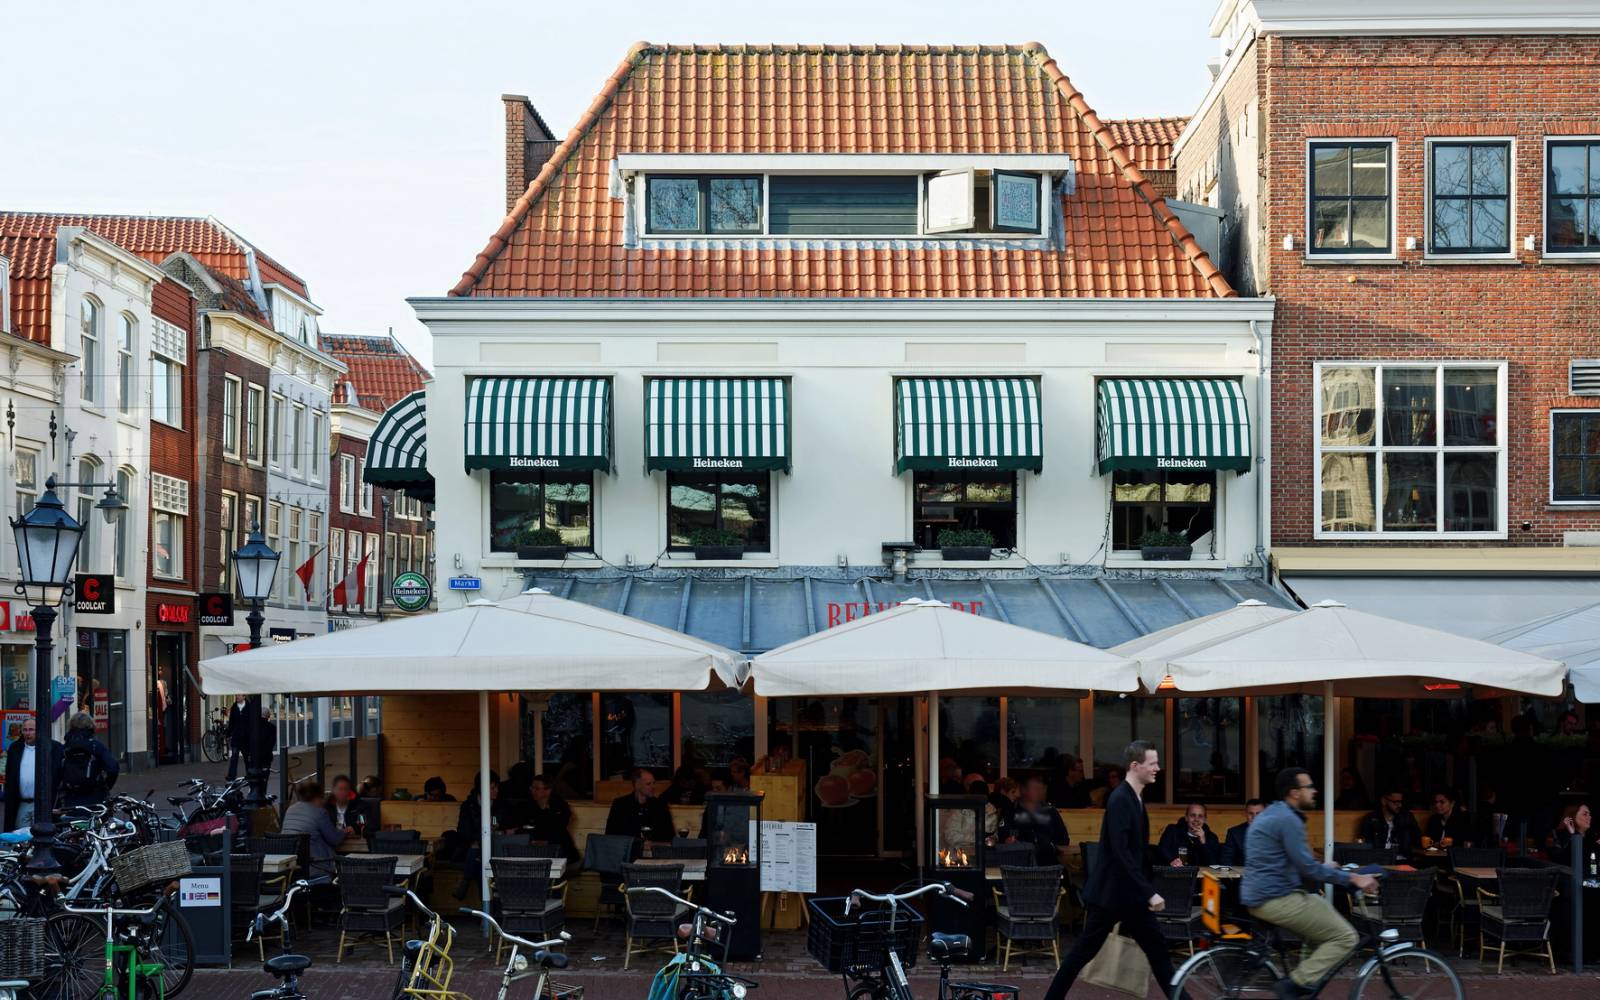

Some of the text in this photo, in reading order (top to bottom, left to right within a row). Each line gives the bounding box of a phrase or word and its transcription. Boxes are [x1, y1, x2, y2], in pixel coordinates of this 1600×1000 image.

[509, 457, 560, 468] Heineken
[692, 458, 743, 469] Heineken
[948, 457, 999, 468] Heineken
[1156, 457, 1208, 468] Heineken
[395, 587, 426, 596] Heineken
[77, 602, 104, 610] COOLCAT
[201, 616, 228, 624] COOLCAT
[272, 634, 292, 642] Phone
[95, 704, 108, 716] SALE
